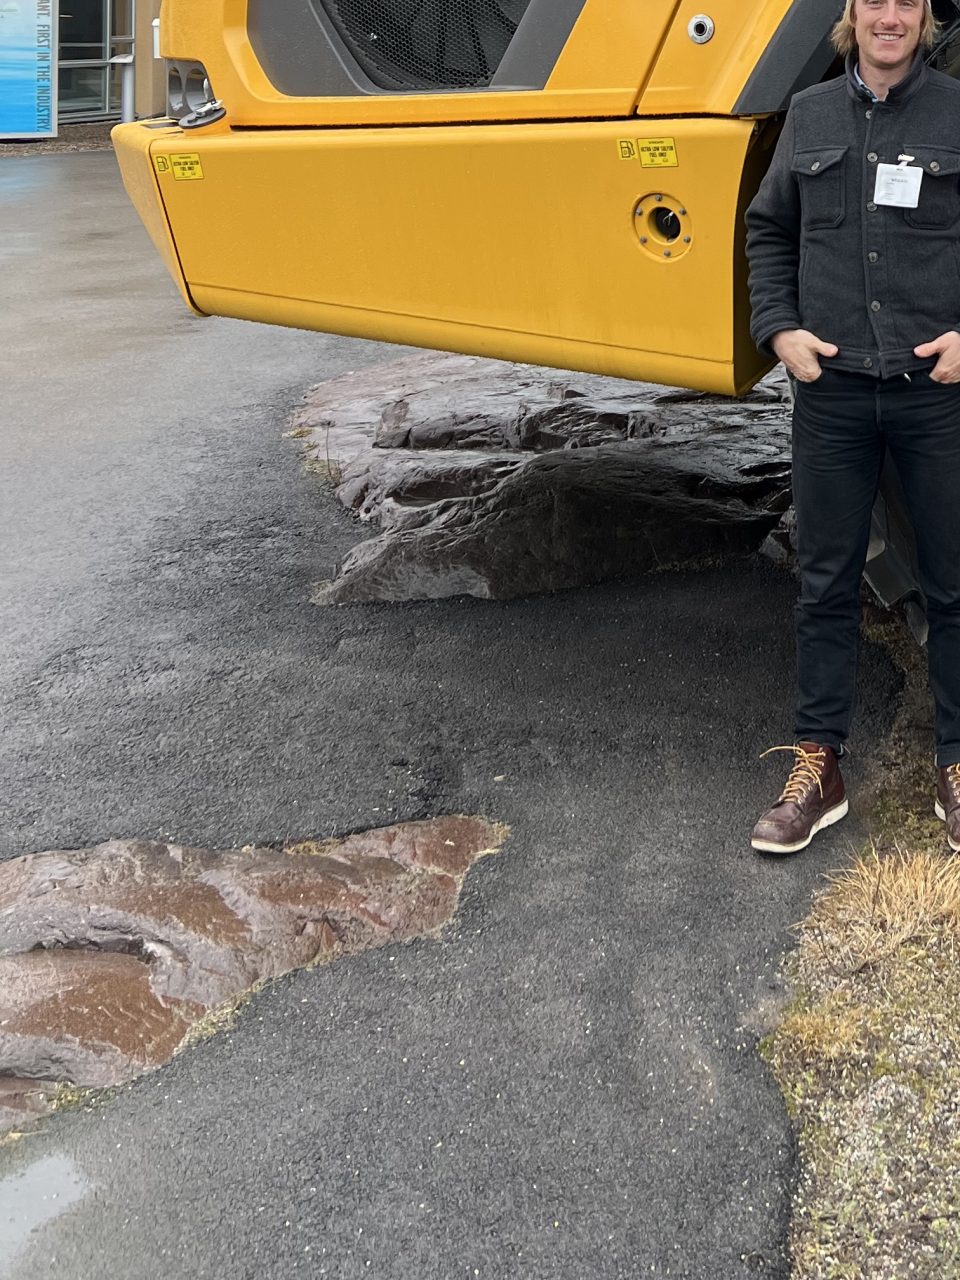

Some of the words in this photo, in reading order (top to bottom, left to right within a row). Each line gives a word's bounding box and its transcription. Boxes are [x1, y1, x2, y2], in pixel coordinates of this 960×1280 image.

[37, 24, 50, 49] FIRST
[37, 52, 50, 61] IN
[37, 65, 50, 82] THE
